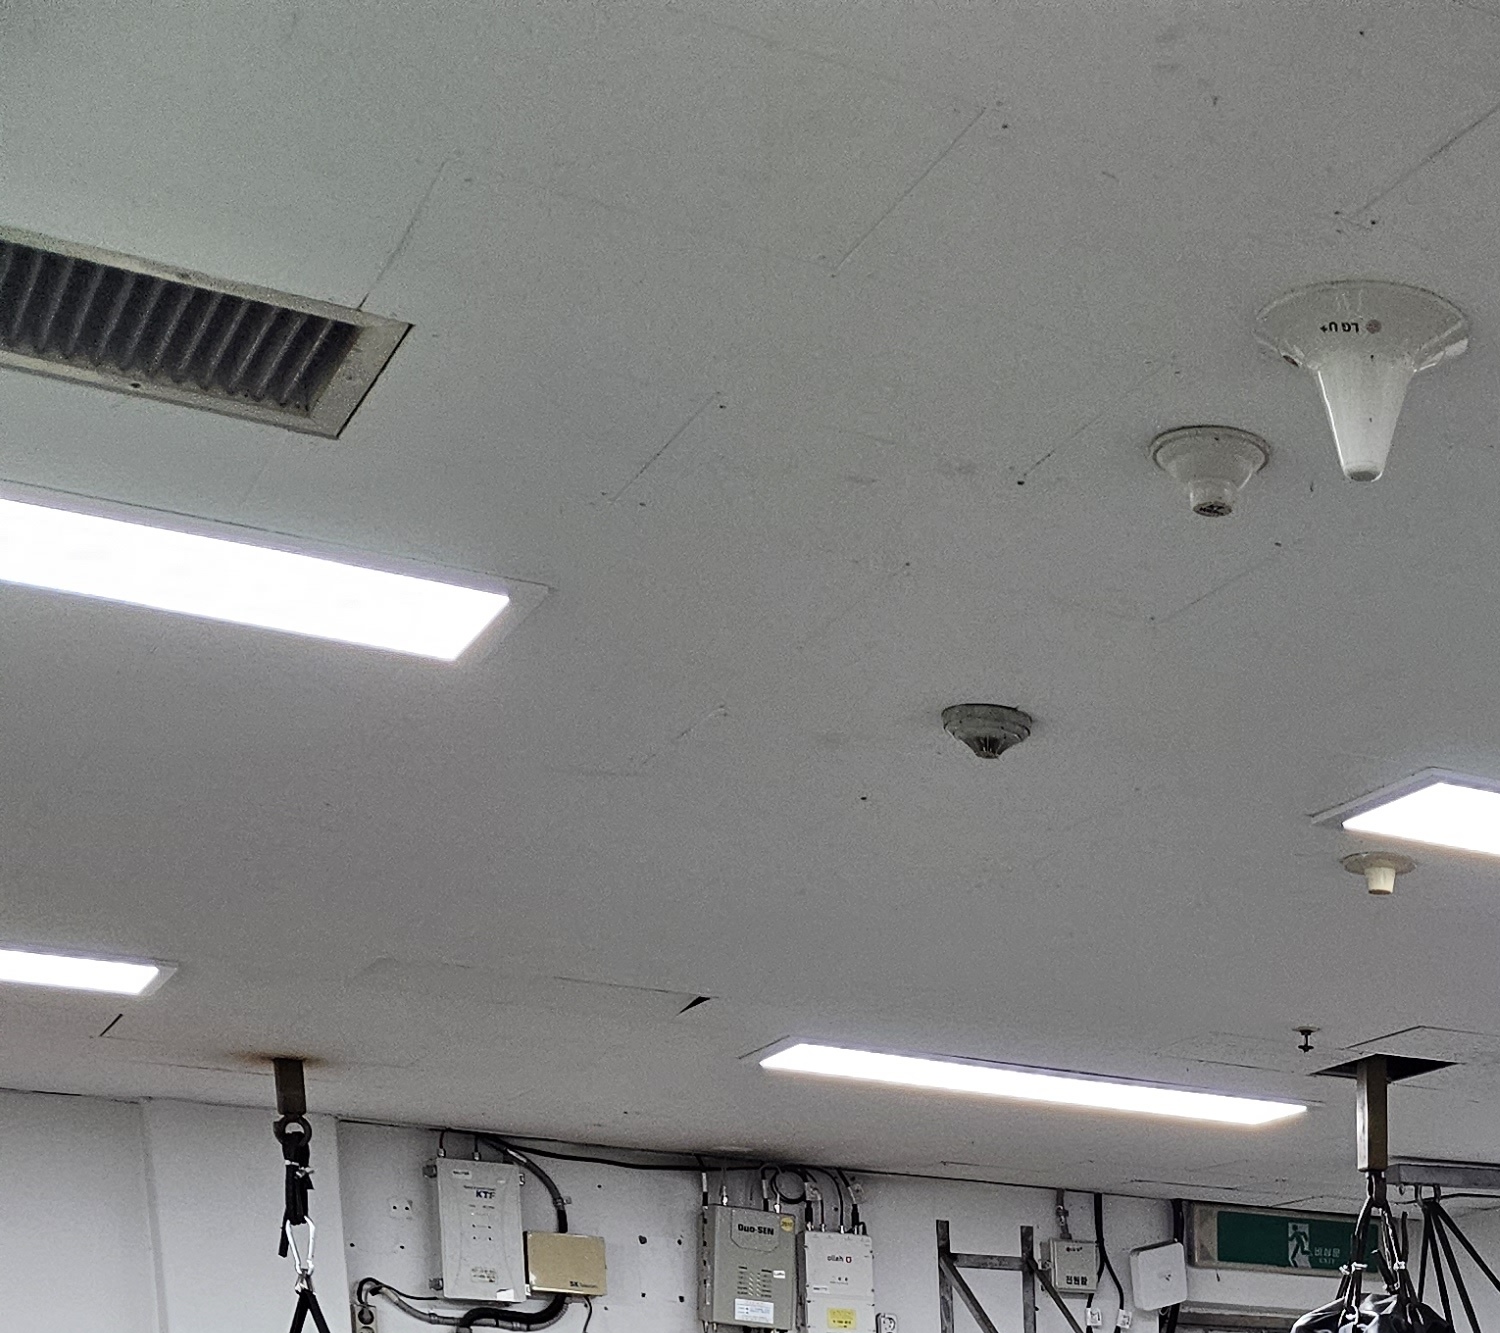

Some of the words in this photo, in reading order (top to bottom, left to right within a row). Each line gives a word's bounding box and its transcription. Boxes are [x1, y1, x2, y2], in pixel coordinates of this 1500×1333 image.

[1341, 322, 1359, 333] LG
[475, 1190, 496, 1199] KTF
[1318, 1257, 1336, 1265] EXIT
